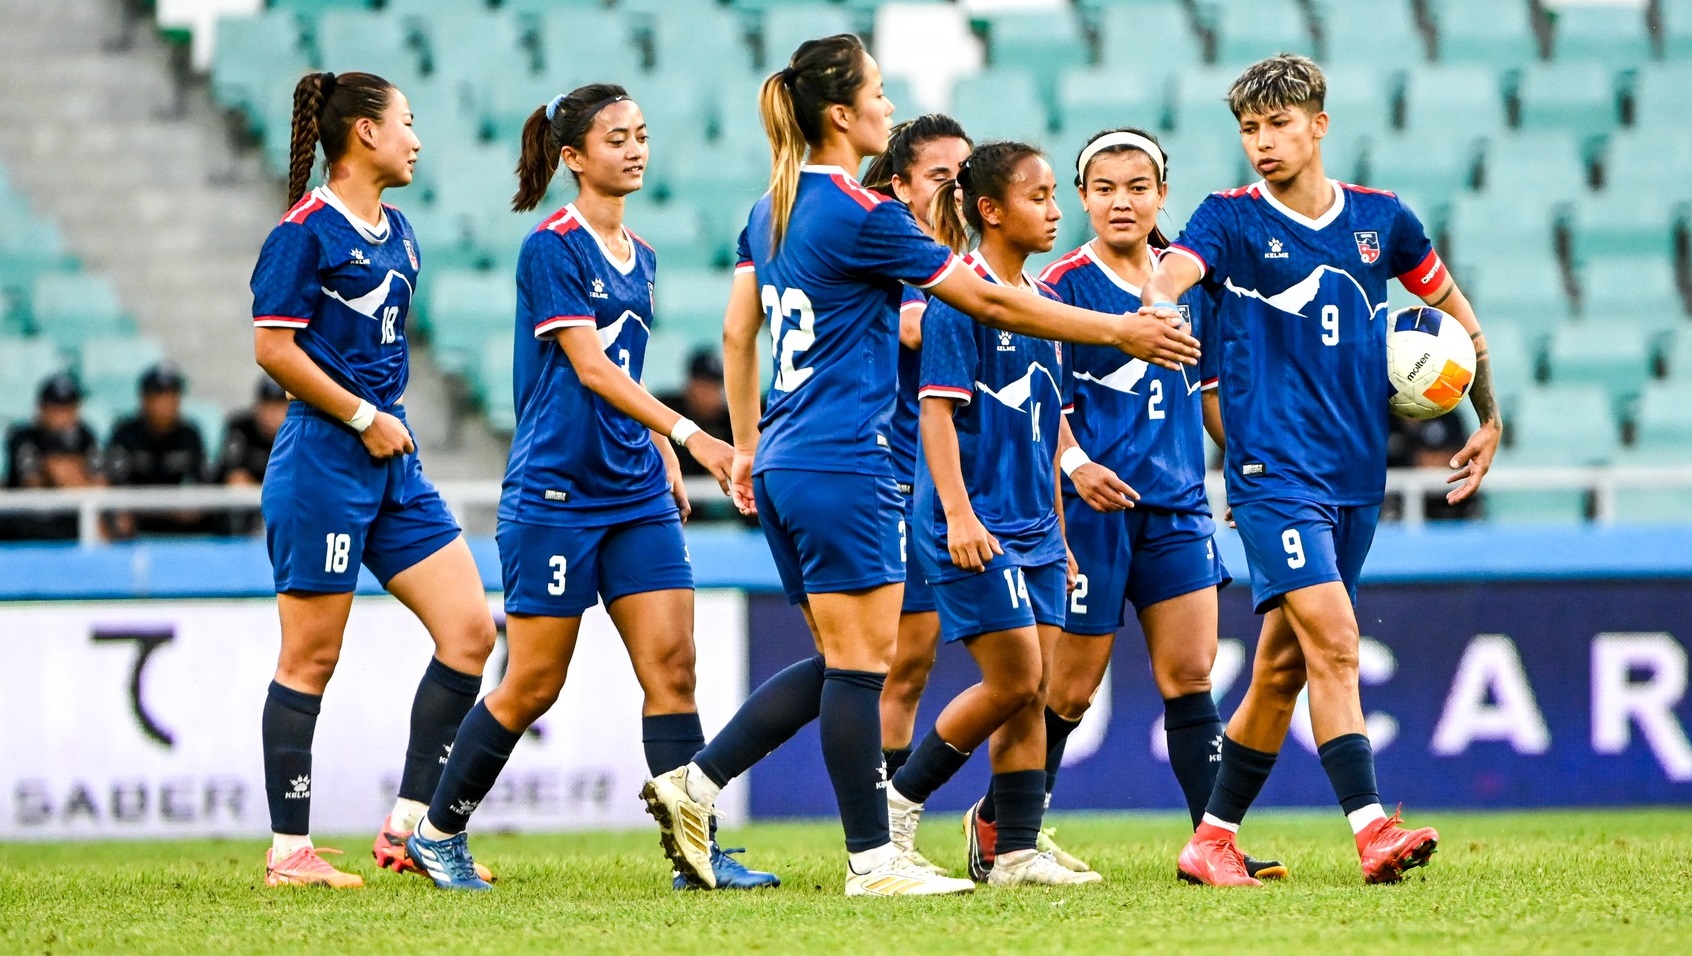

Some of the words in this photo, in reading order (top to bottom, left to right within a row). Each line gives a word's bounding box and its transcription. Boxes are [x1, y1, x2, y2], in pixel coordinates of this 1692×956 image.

[381, 306, 399, 345] 18
[761, 284, 816, 393] 22
[1321, 304, 1340, 347] 9
[1407, 353, 1431, 382] molten
[1148, 379, 1166, 420] 2
[324, 532, 352, 574] 18
[1281, 528, 1306, 570] 9
[547, 554, 567, 596] 3
[1003, 566, 1032, 609] 14
[1070, 573, 1089, 615] 2
